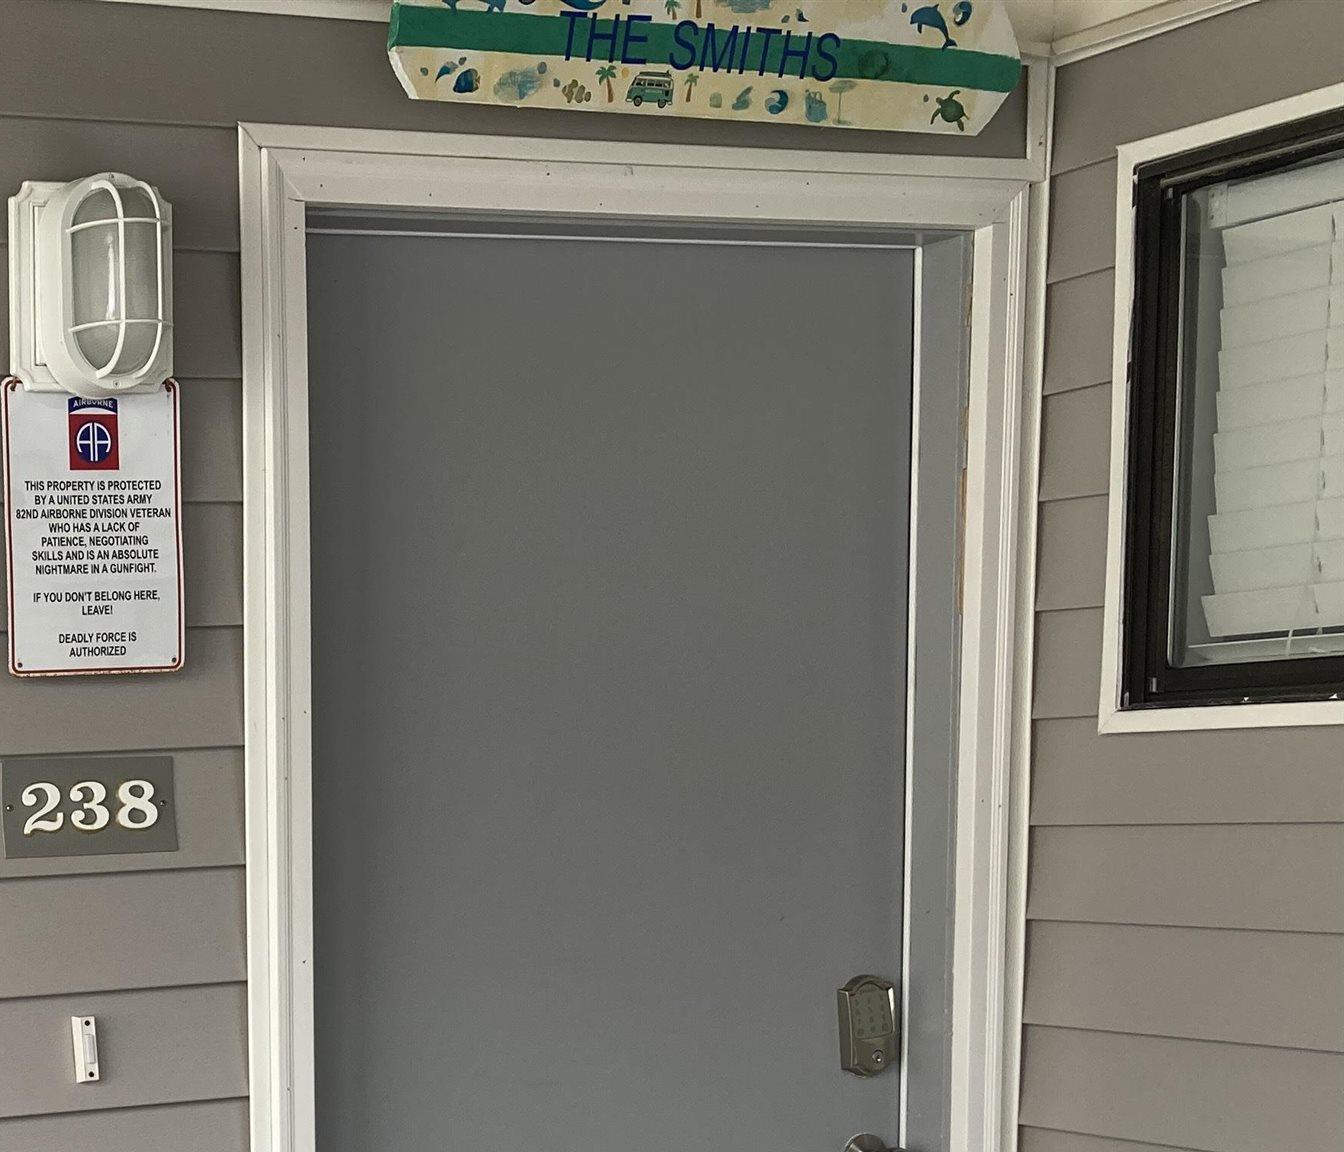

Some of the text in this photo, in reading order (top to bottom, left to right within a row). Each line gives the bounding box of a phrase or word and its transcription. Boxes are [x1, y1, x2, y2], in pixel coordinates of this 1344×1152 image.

[560, 10, 841, 82] THE SMITHS
[25, 480, 161, 491] THIS PROPERTY IS PROTECTED
[35, 494, 152, 505] BY A UNITED STATES ARMY
[16, 508, 171, 519] 82ND AIRBORNE DIVISION VETERAN
[49, 522, 140, 533] WHO HAS A LACK OF
[42, 536, 148, 547] PATIENCE, NEGOTIATING
[32, 549, 159, 561] SKILLS AND IS AN ABSOLUTE
[36, 563, 156, 574] NIGHTMARE IN A GUNFIGHT.
[33, 590, 160, 602] IF YOU DON'T BELONG HERE,
[82, 605, 113, 615] LEAVE!
[59, 632, 137, 643] DEADLY FORCE IS
[69, 646, 126, 657] AUTHORIZED
[21, 780, 159, 835] 238
